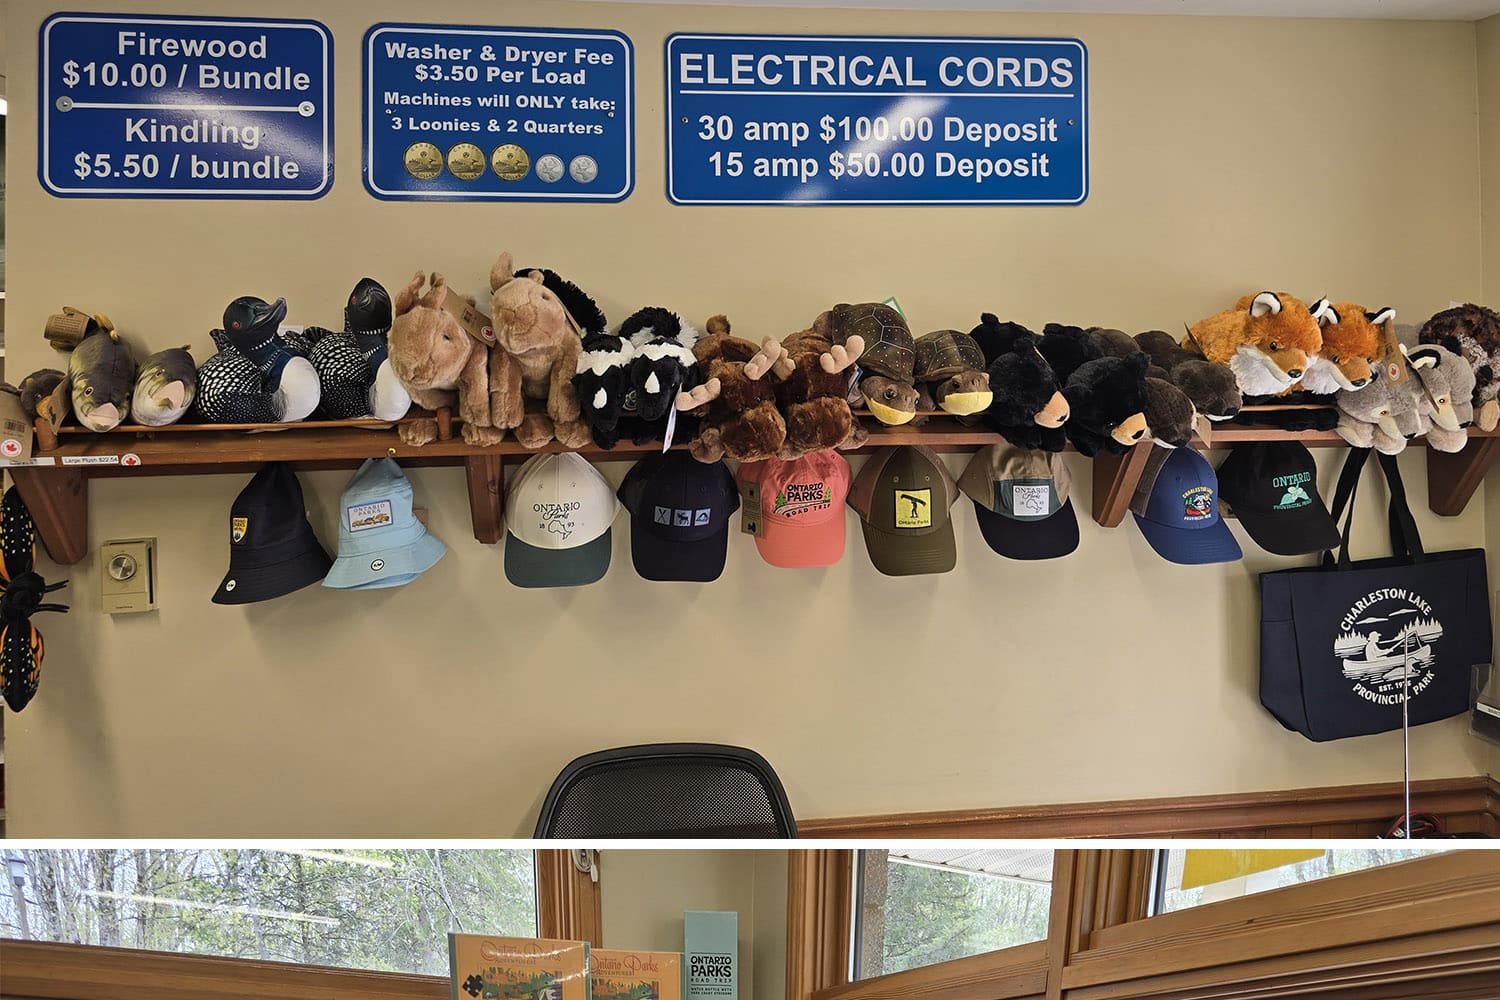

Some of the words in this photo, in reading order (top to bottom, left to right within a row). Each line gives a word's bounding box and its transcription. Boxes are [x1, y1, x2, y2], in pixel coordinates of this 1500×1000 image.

[117, 31, 267, 59] Firewood
[385, 42, 473, 63] Washer
[479, 45, 497, 62] &
[505, 45, 567, 68] Dryer
[573, 48, 614, 65] Fee
[62, 60, 167, 89] $10.00
[178, 65, 190, 89] /
[199, 66, 311, 91] Bundle
[415, 63, 478, 83] $3.50
[486, 66, 525, 84] Per
[530, 67, 586, 85] Load
[679, 53, 927, 88] ELECTRICAL
[938, 57, 1074, 89] CORDS
[384, 91, 463, 108] Machines
[470, 94, 509, 109] will
[514, 95, 566, 110] ONLY
[571, 96, 616, 112] take:
[125, 118, 261, 150] Kindling
[391, 117, 402, 131] 3
[408, 117, 481, 132] Loonies
[487, 119, 501, 132] &
[507, 119, 518, 133] 2
[523, 120, 604, 136] Quarters
[699, 115, 733, 142] 30
[743, 121, 810, 148] amp
[819, 114, 933, 143] $100.00
[944, 117, 1058, 148] Deposit
[74, 152, 160, 180] $5.50
[169, 154, 180, 179] /
[191, 152, 300, 180] bundle
[708, 151, 743, 177] 15
[753, 156, 819, 183] amp
[828, 150, 925, 180] $50.00
[936, 152, 1050, 184] Deposit
[787, 482, 824, 492] ONTARIO
[1272, 471, 1311, 488] ONTARIO
[787, 490, 823, 502] PARKS
[532, 501, 582, 513] ONTARIO
[542, 508, 570, 521] Parks
[786, 508, 809, 518] ROAD
[813, 503, 831, 511] TRIP
[1340, 587, 1407, 632] CHARLESTON
[1407, 591, 1433, 616] LAKE
[1378, 684, 1394, 692] EST.
[1412, 669, 1436, 696] PARK
[690, 956, 732, 964] ONTARIO
[691, 965, 732, 977] PARKS
